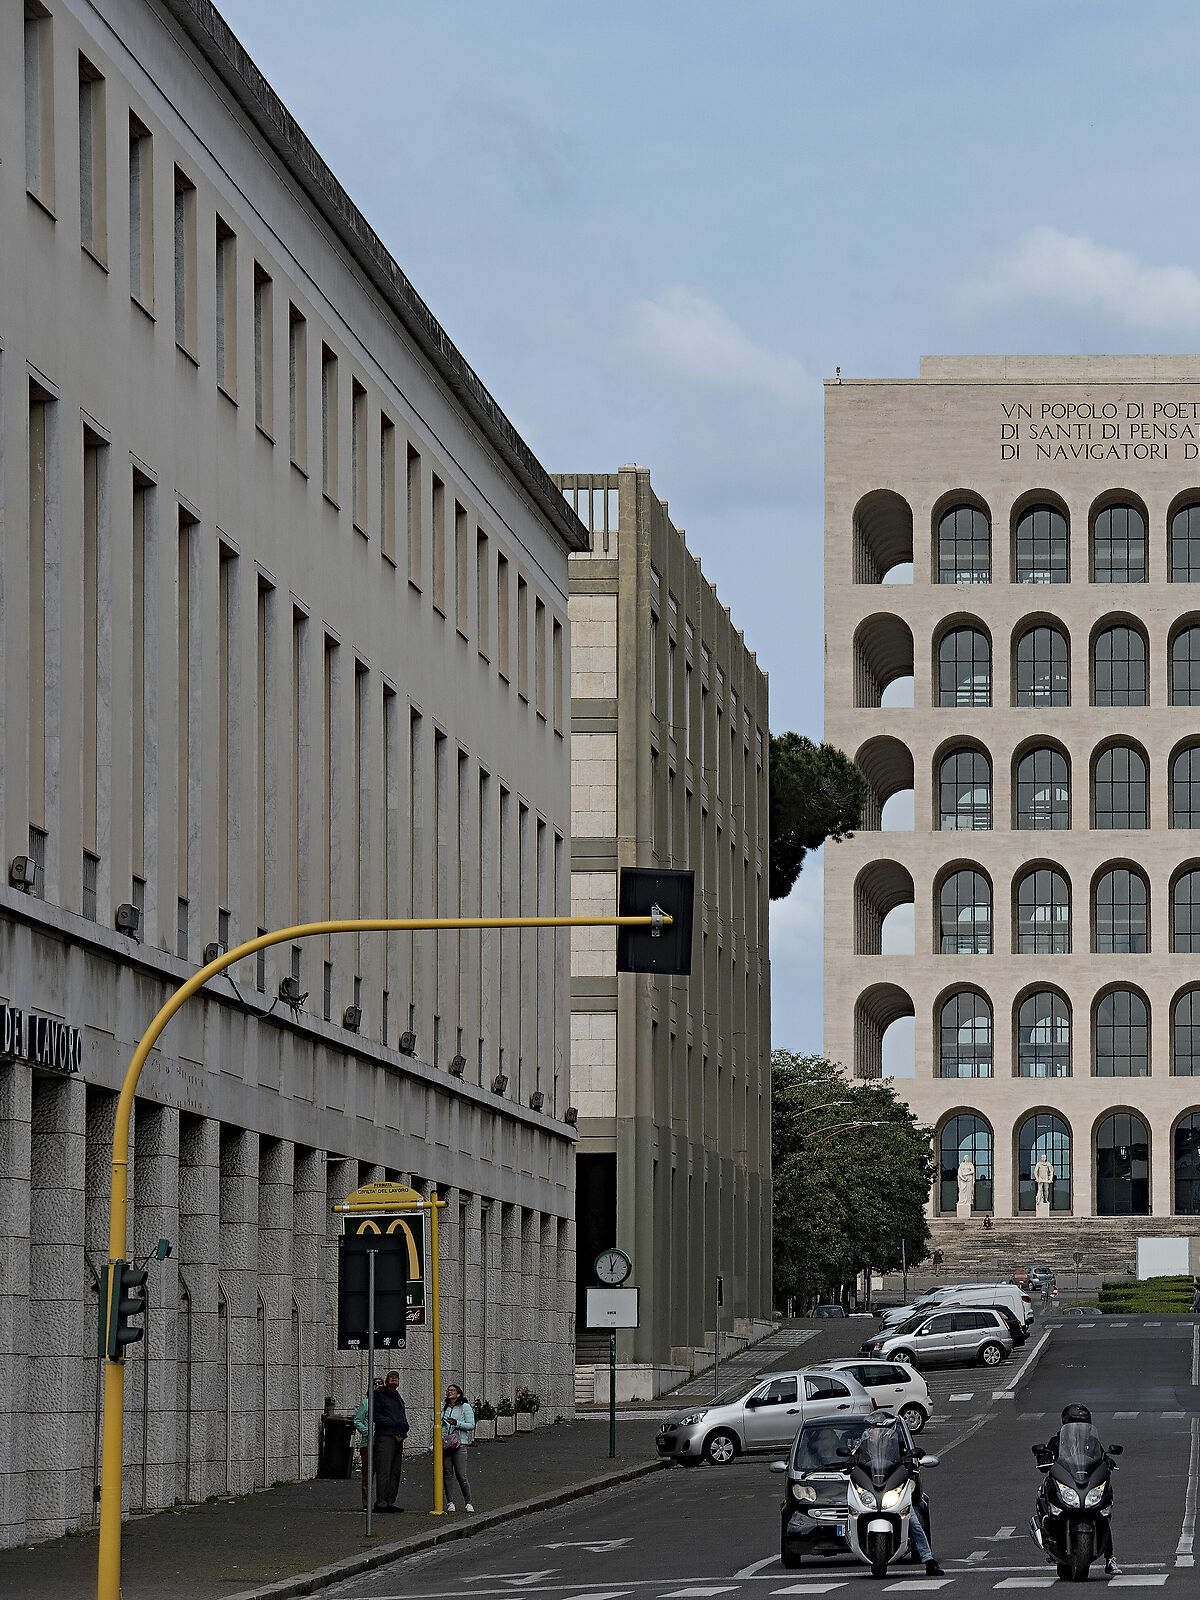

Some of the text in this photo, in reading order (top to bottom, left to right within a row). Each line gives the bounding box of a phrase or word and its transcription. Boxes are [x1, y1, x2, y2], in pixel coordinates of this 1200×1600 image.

[1000, 402, 1032, 419] VN
[1041, 402, 1120, 419] POPOLO
[1126, 402, 1145, 419] DI
[1000, 422, 1020, 440] DI
[1028, 422, 1092, 440] SANTI
[1101, 422, 1120, 439] DI
[1000, 443, 1020, 460] DI
[1035, 443, 1168, 460] NAVIGATORI
[3, 1004, 83, 1074] DEL LAVORO
